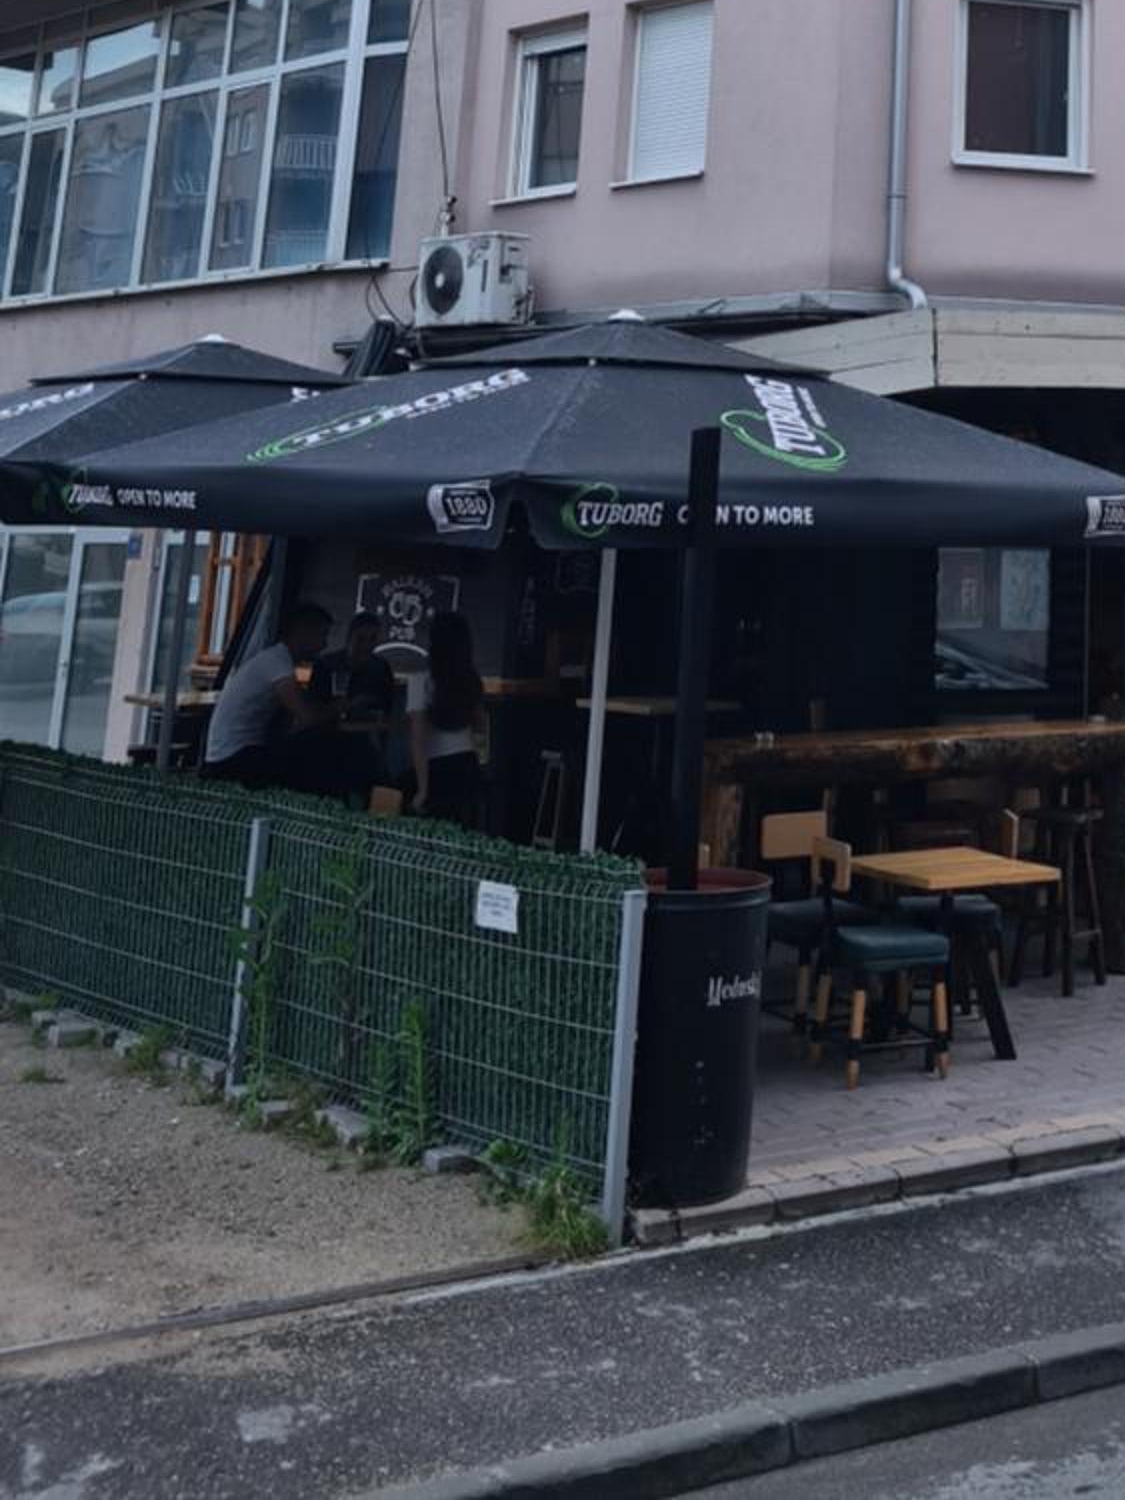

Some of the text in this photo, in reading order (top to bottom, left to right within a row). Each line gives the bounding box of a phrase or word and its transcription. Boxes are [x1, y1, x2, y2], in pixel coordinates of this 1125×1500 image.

[145, 489, 161, 508] TO
[163, 490, 197, 511] MORE
[577, 500, 664, 527] TUBORG
[733, 505, 760, 525] TO
[763, 505, 814, 526] MORE
